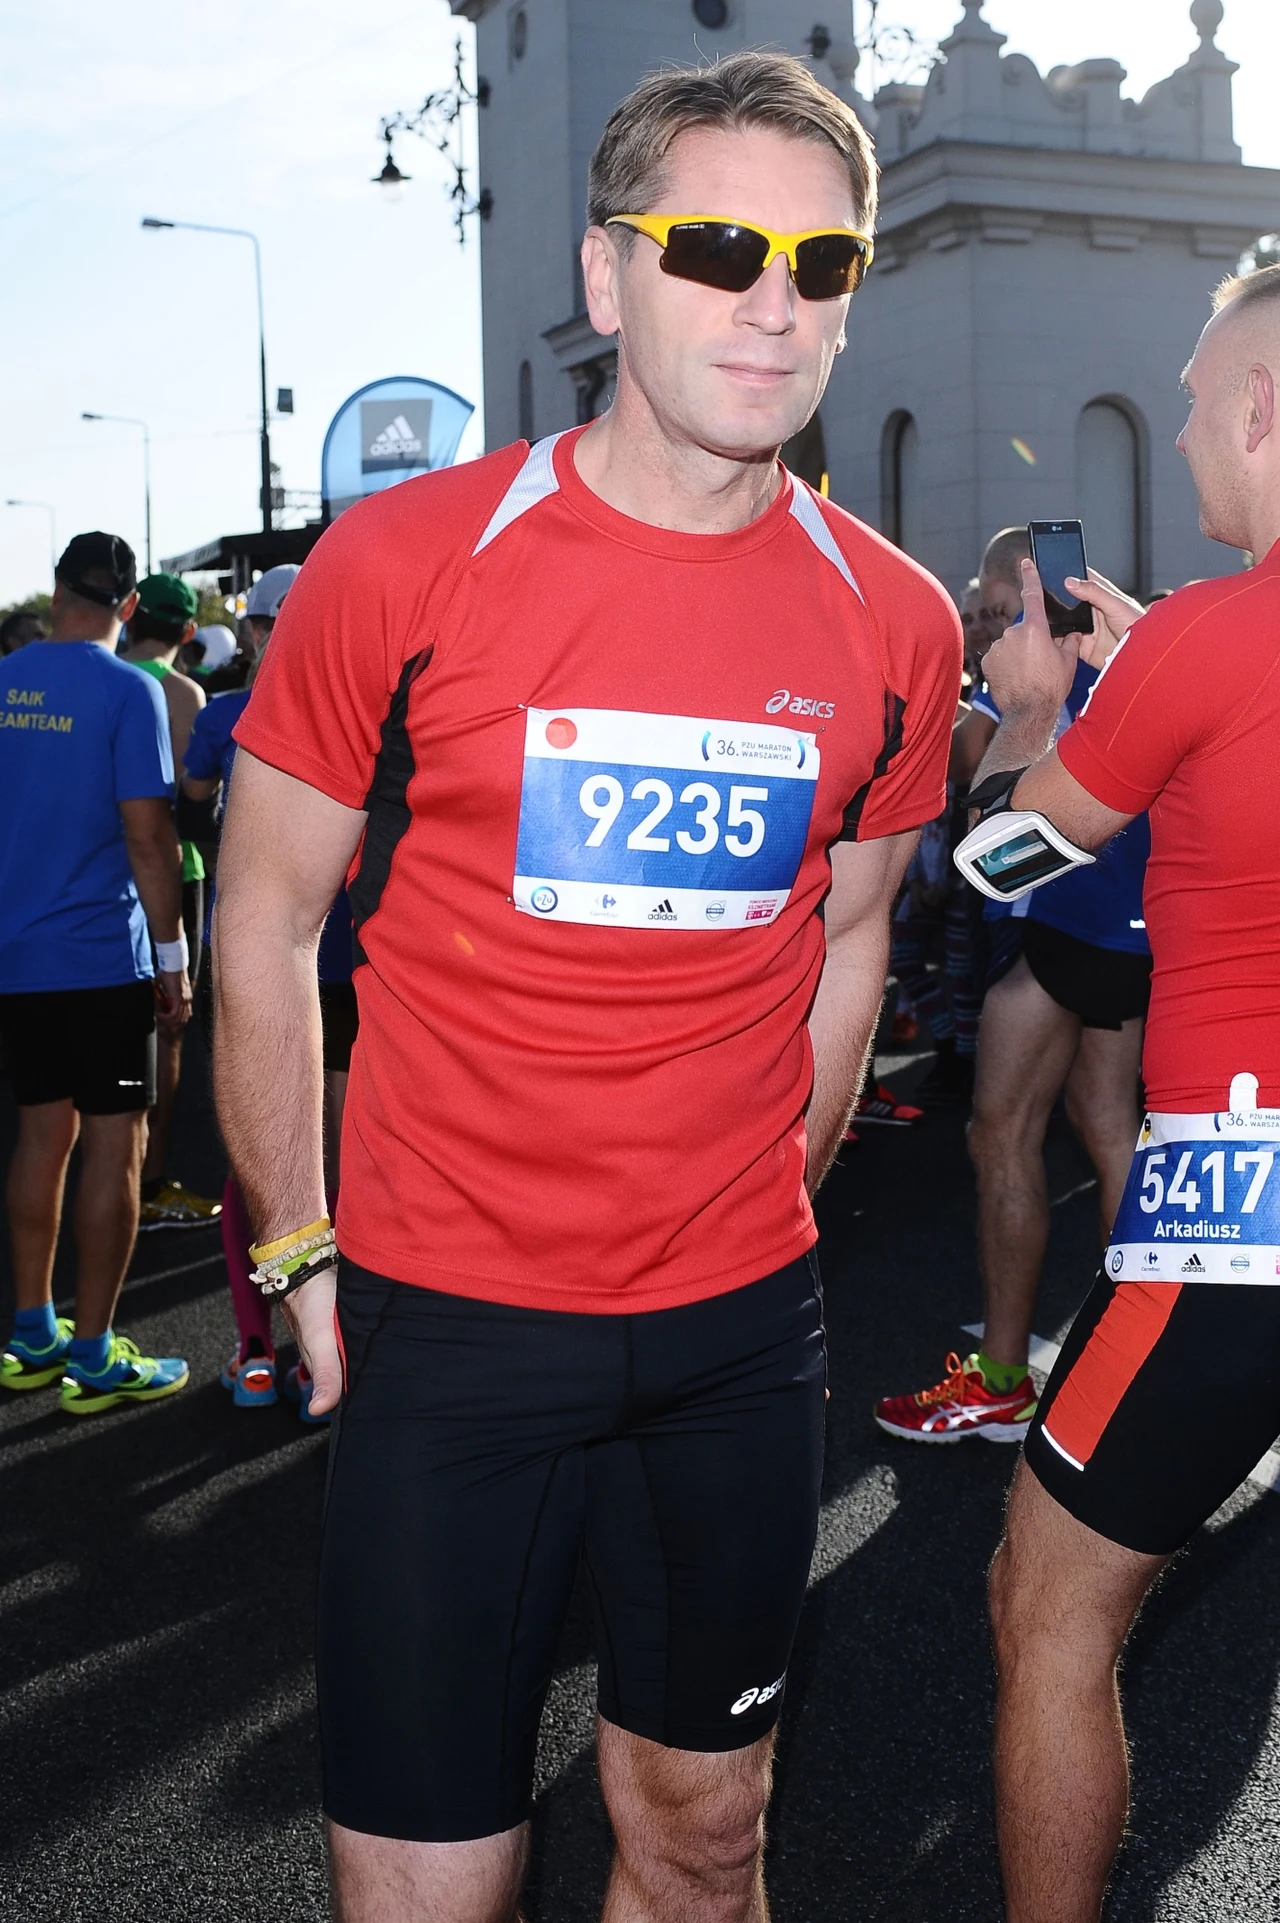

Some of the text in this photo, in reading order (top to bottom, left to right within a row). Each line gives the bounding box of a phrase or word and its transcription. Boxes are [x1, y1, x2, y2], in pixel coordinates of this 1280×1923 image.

[369, 439, 422, 456] adidas
[6, 688, 46, 707] SAIK
[788, 696, 836, 719] asics
[716, 739, 739, 757] 36.
[741, 741, 792, 753] PZU MARATON
[741, 751, 792, 761] WARSZAWSKI
[579, 774, 769, 858] 9235
[536, 893, 553, 906] PZU
[647, 912, 678, 921] adidas
[1226, 1112, 1248, 1127] 36.
[1139, 1151, 1274, 1214] 5417
[1153, 1219, 1241, 1239] Arkadiusz
[1181, 1264, 1206, 1273] adidas
